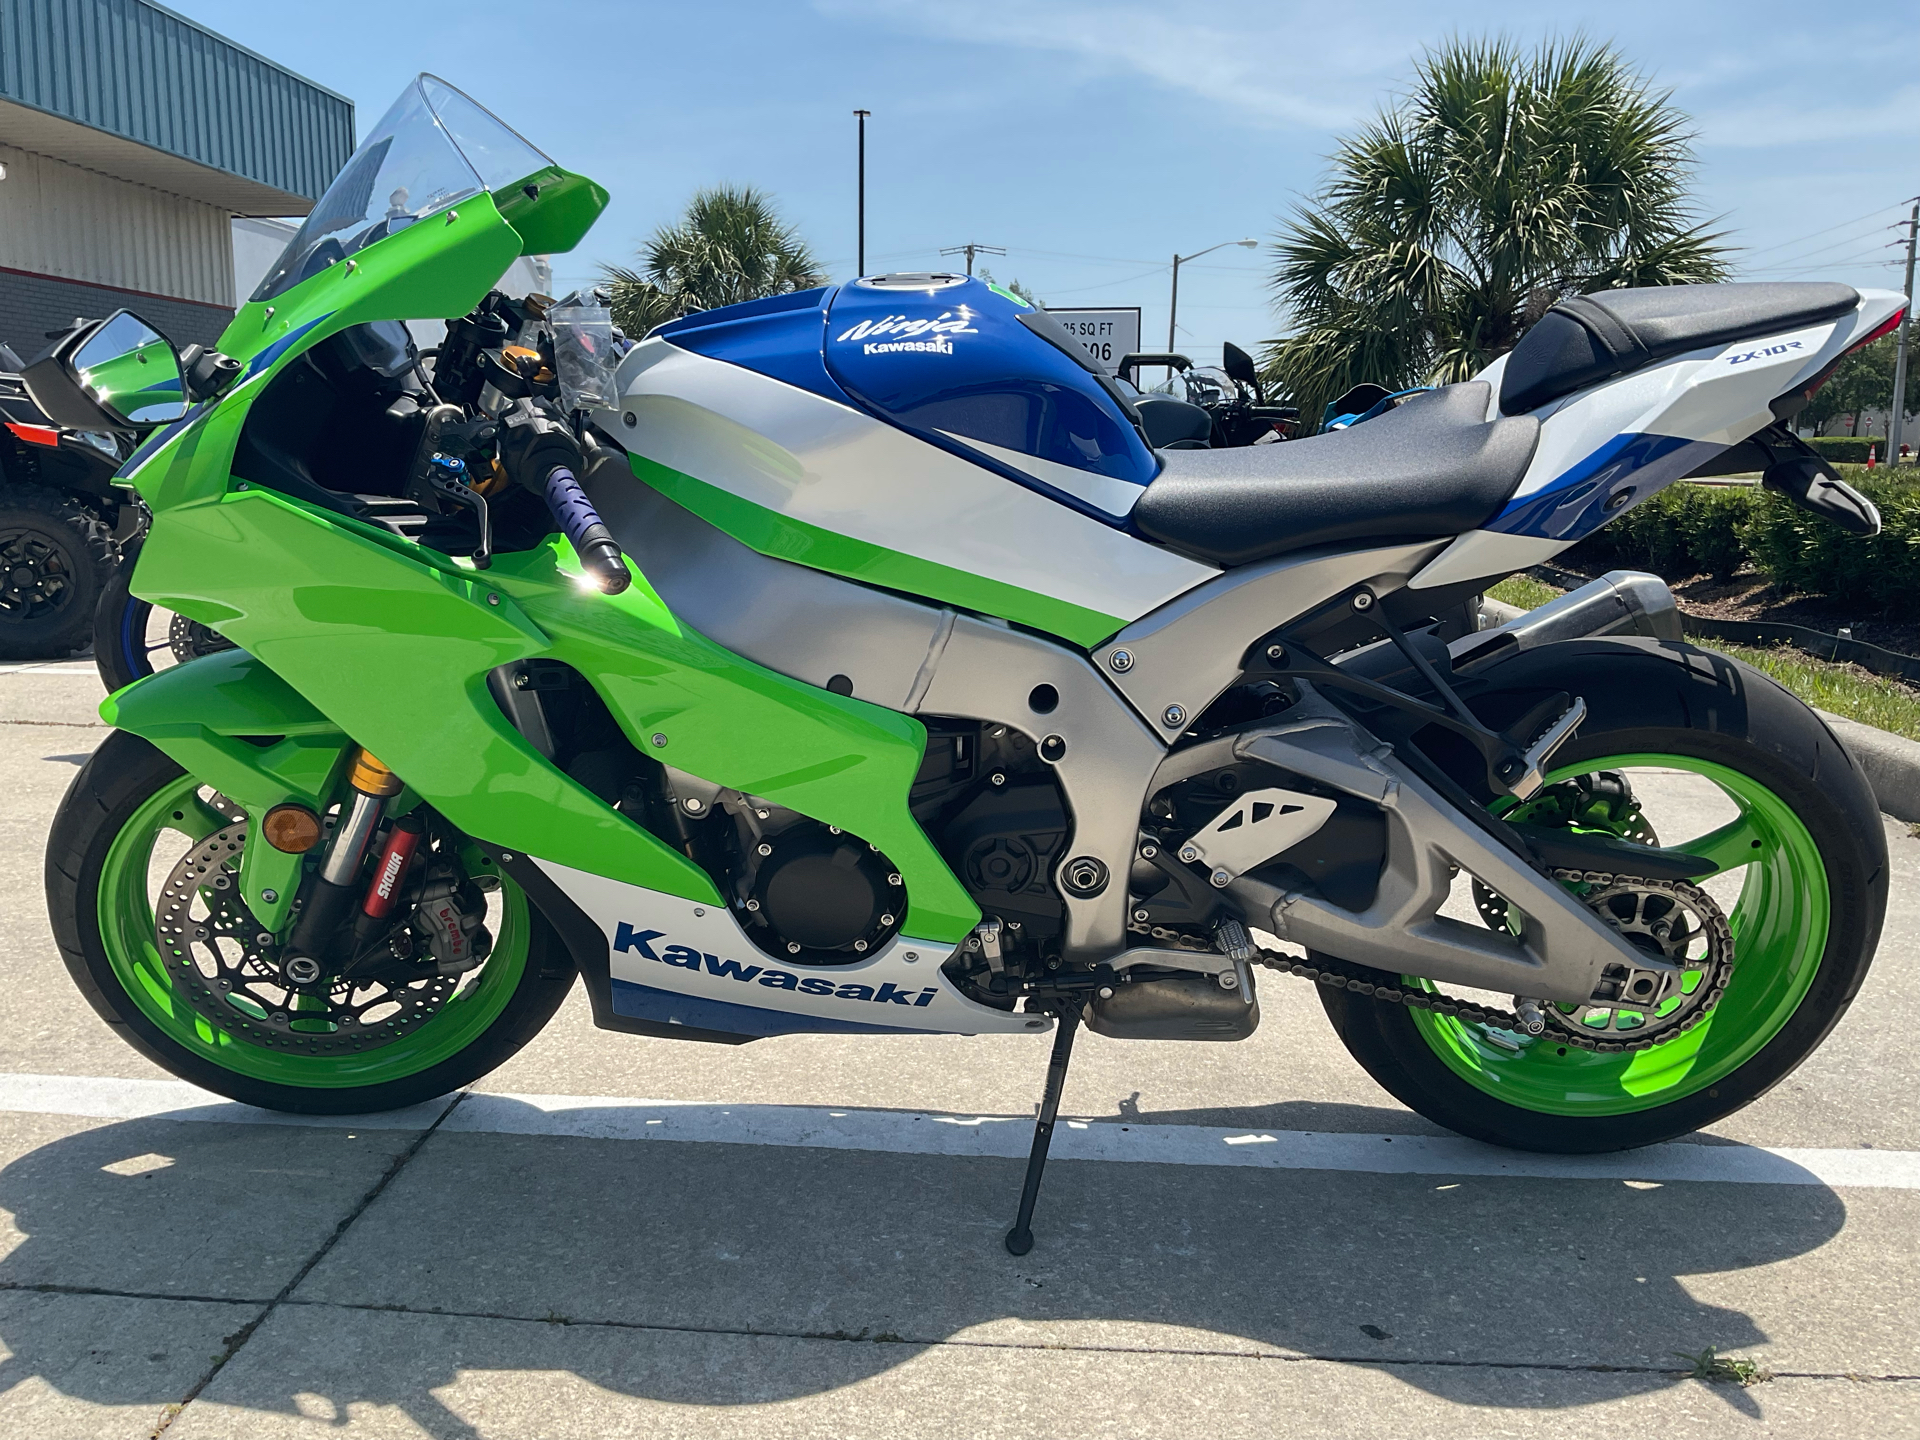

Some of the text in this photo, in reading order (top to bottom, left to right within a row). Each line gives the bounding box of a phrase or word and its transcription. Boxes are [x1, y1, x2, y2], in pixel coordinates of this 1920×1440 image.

[837, 312, 978, 342] Ninja
[1079, 322, 1095, 336] SQ
[1099, 322, 1114, 336] FT
[863, 341, 954, 356] Kawasaki
[1725, 341, 1805, 365] ZX-10R
[376, 851, 404, 900] SHOWA
[438, 908, 466, 955] brembo
[612, 920, 940, 1007] Kawasaki
